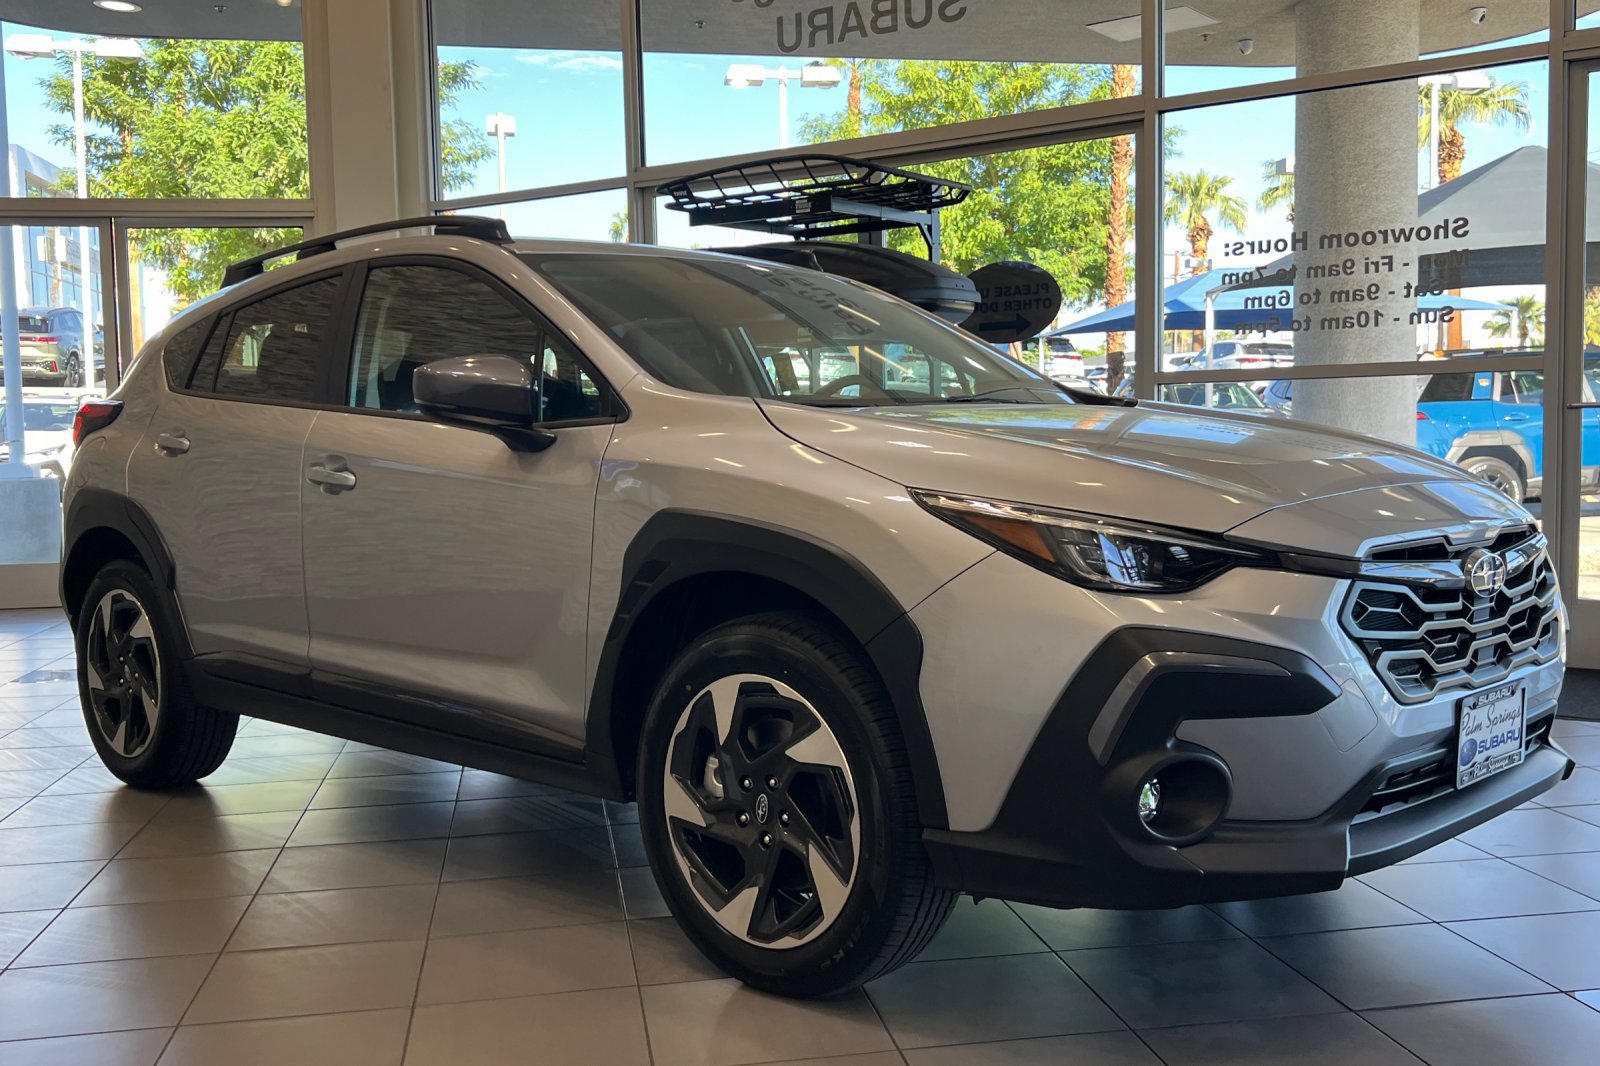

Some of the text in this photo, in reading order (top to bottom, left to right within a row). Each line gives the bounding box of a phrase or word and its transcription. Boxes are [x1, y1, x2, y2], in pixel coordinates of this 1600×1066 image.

[1478, 686, 1512, 704] SUBARU
[1462, 703, 1520, 736] Palm Springs
[1478, 727, 1521, 754] SUBARU
